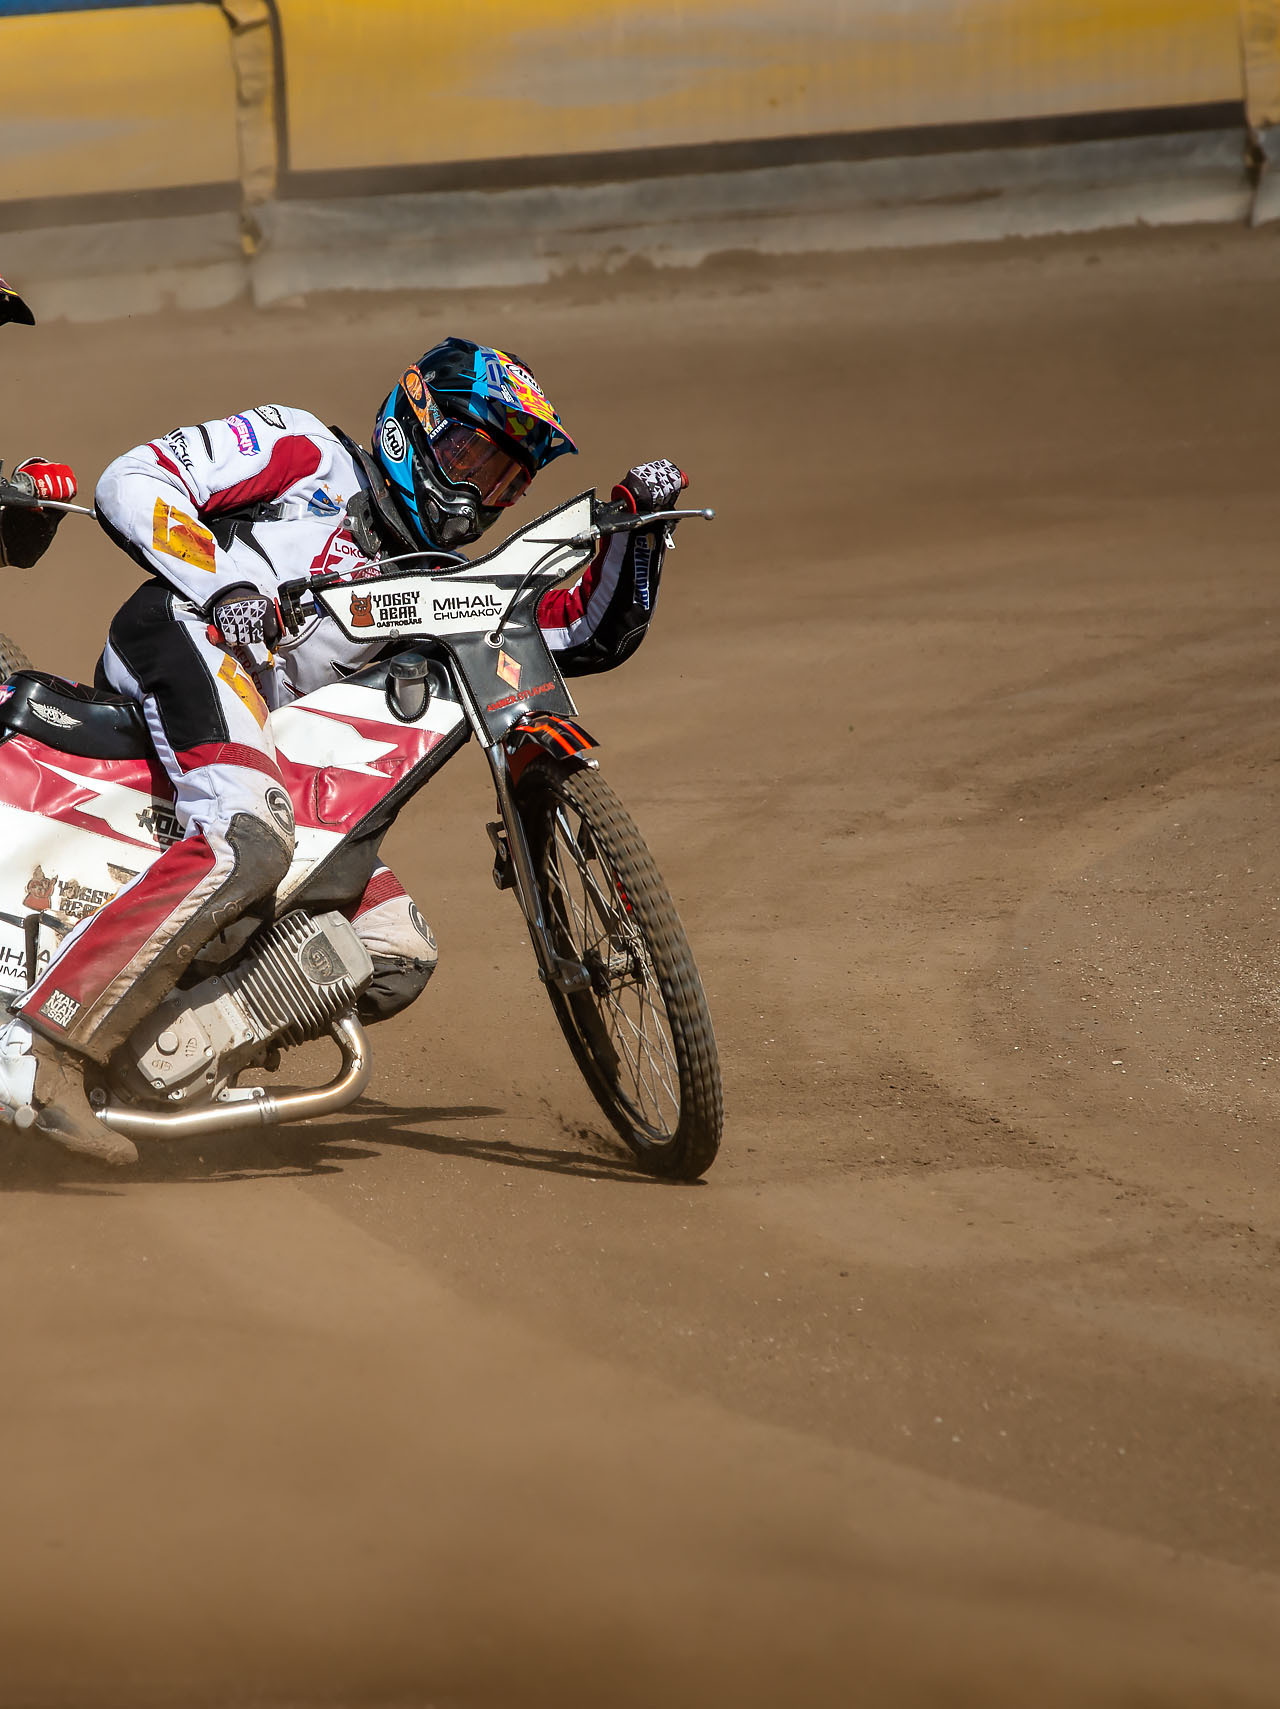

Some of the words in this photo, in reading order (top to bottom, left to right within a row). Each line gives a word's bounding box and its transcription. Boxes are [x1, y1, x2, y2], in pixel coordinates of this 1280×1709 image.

[384, 421, 405, 456] Arai
[373, 591, 420, 607] YOGGY
[433, 594, 502, 612] MIHAIL
[380, 606, 417, 621] BEAR
[434, 608, 502, 621] CHUMAKOV
[487, 695, 518, 713] AMBER
[519, 681, 556, 701] STUDIOS
